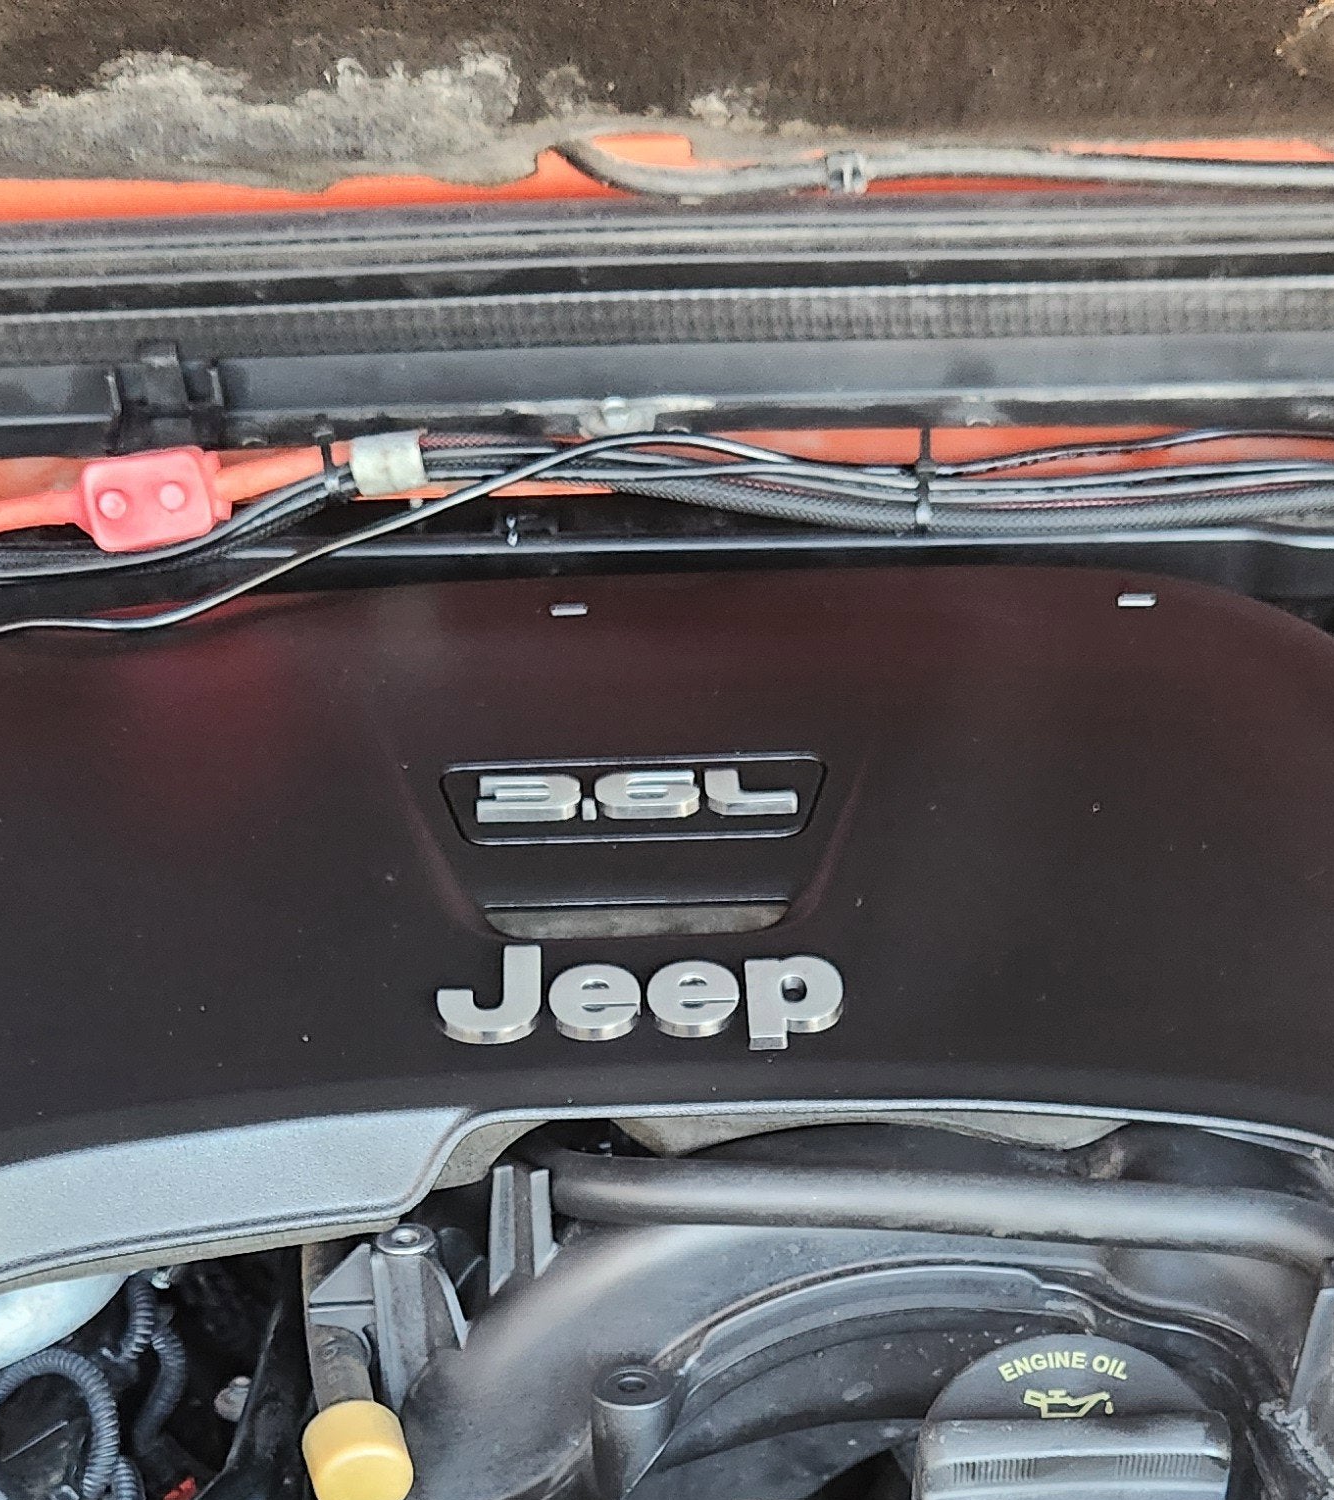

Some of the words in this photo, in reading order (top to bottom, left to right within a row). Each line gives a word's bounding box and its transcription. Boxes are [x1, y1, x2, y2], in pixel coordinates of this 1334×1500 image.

[476, 768, 799, 824] 3.6L
[436, 944, 844, 1051] Jeep
[997, 1351, 1087, 1383] ENGINE
[1092, 1354, 1129, 1381] OIL
